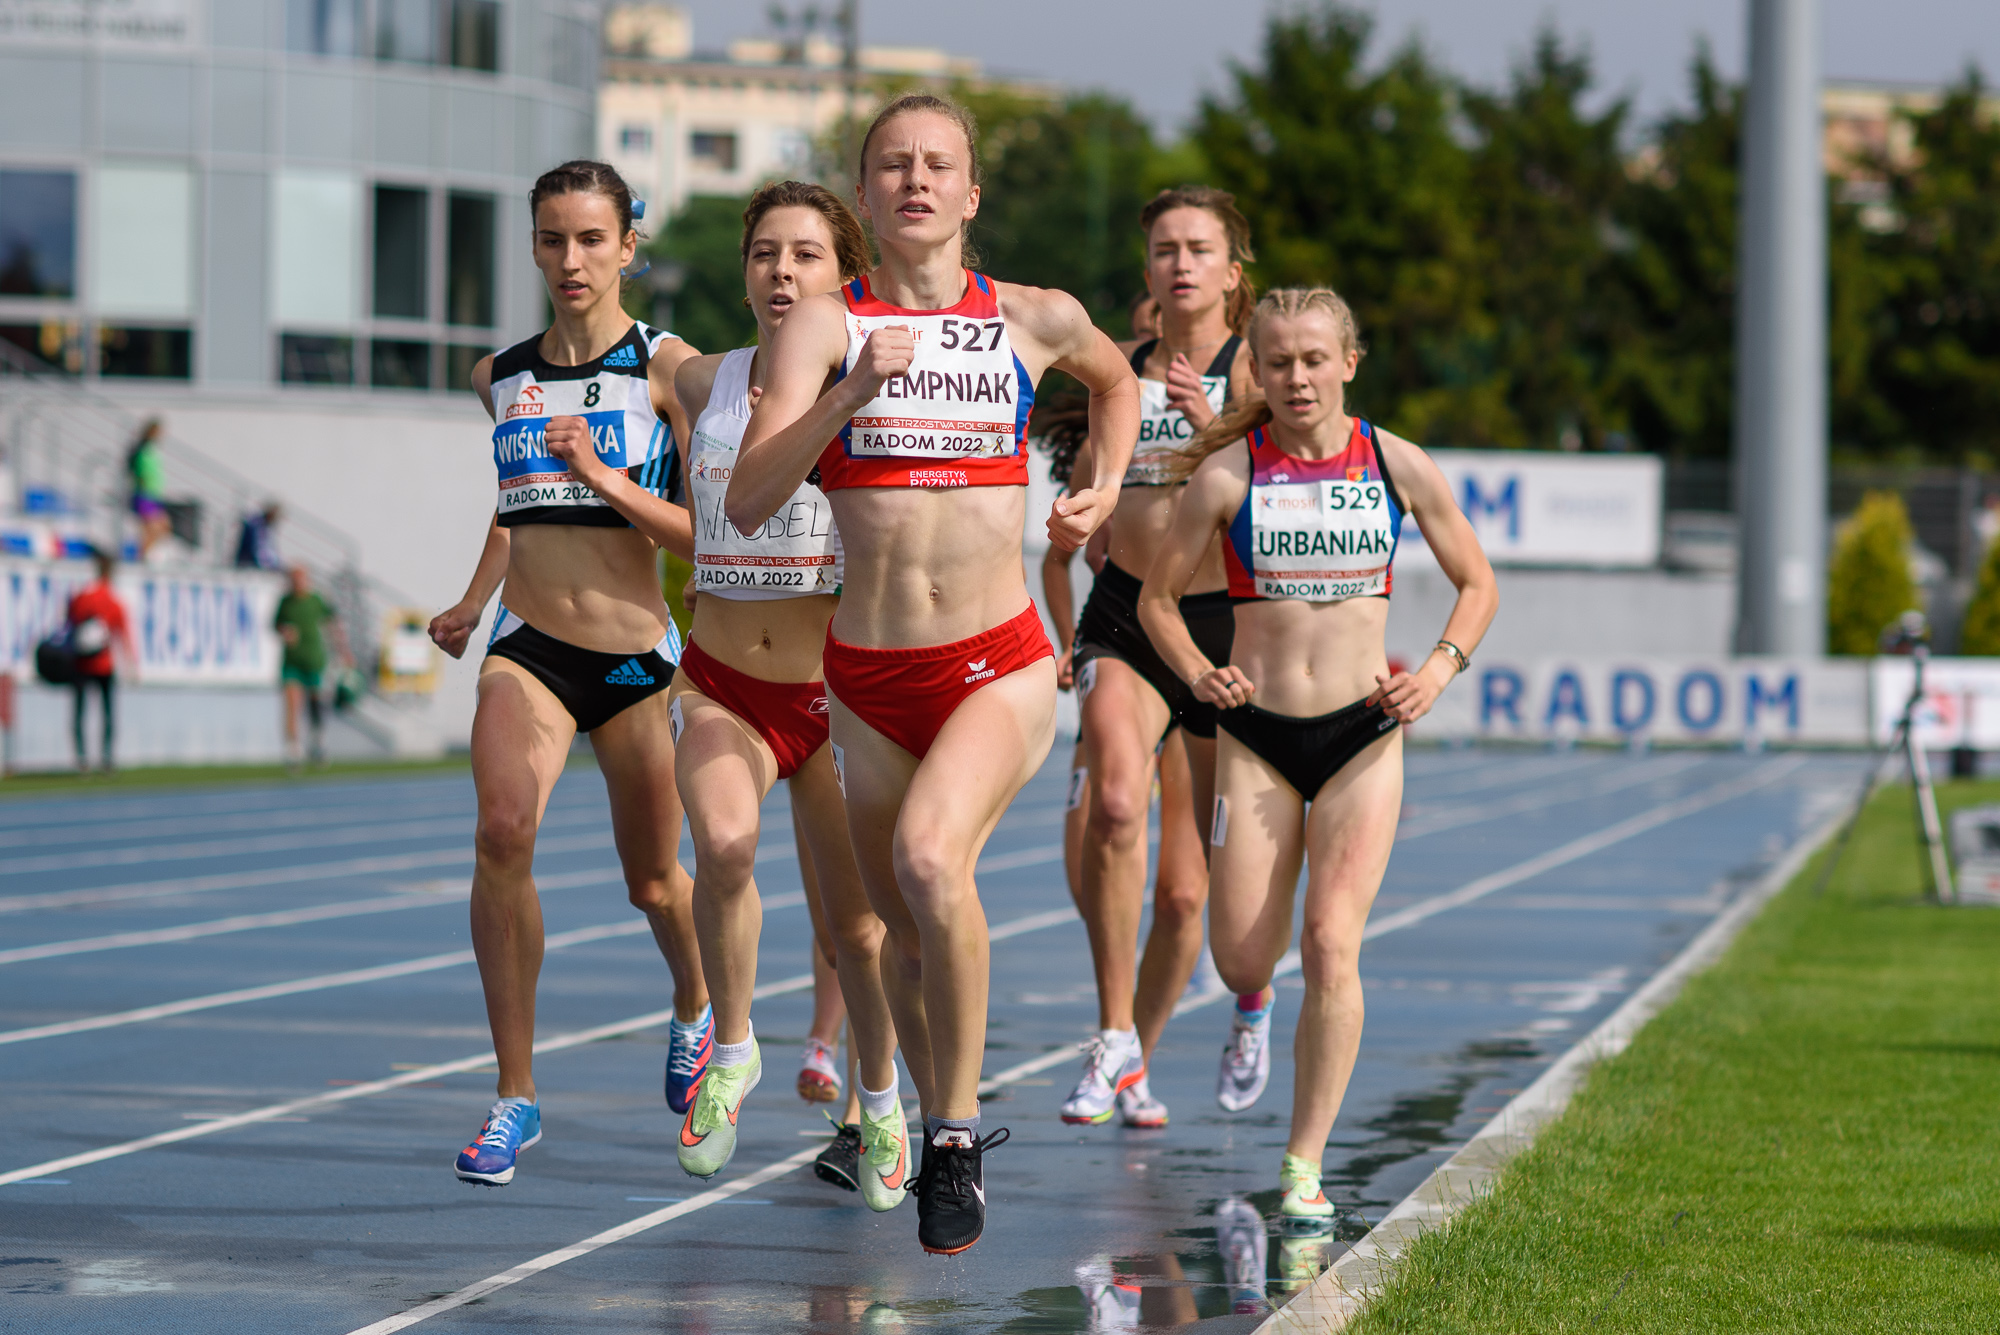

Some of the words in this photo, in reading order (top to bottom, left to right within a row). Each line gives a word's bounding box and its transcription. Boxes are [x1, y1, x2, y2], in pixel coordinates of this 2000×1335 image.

[940, 319, 1005, 352] 527
[603, 356, 640, 367] adidas
[583, 382, 601, 408] 8
[877, 370, 1012, 405] EMPNIAK
[507, 404, 541, 417] ORLEN
[854, 418, 878, 427] PZLA
[880, 419, 955, 430] MISTRZOSTWA
[957, 422, 993, 432] POLSKI
[995, 424, 1013, 433] U20
[496, 425, 620, 465] WIŚNIKA
[863, 434, 935, 450] RADOM
[941, 436, 984, 452] 2022
[910, 470, 967, 479] ENERGETYK
[506, 487, 556, 507] RADOM
[1278, 496, 1317, 508] mosir
[1330, 486, 1382, 510] 529
[1259, 529, 1389, 557] URBANIAK
[711, 556, 774, 566] MISTRZOSTWA
[775, 556, 810, 566] POLSKI
[812, 557, 832, 565] U20
[700, 570, 757, 585] RADOM
[761, 572, 804, 586] 2022
[1264, 583, 1326, 596] RADOM
[1332, 582, 1365, 596] 2022
[605, 674, 655, 686] adidas
[965, 668, 995, 684] erima
[1480, 668, 1800, 732] RADOM
[946, 1135, 962, 1143] NIKE
